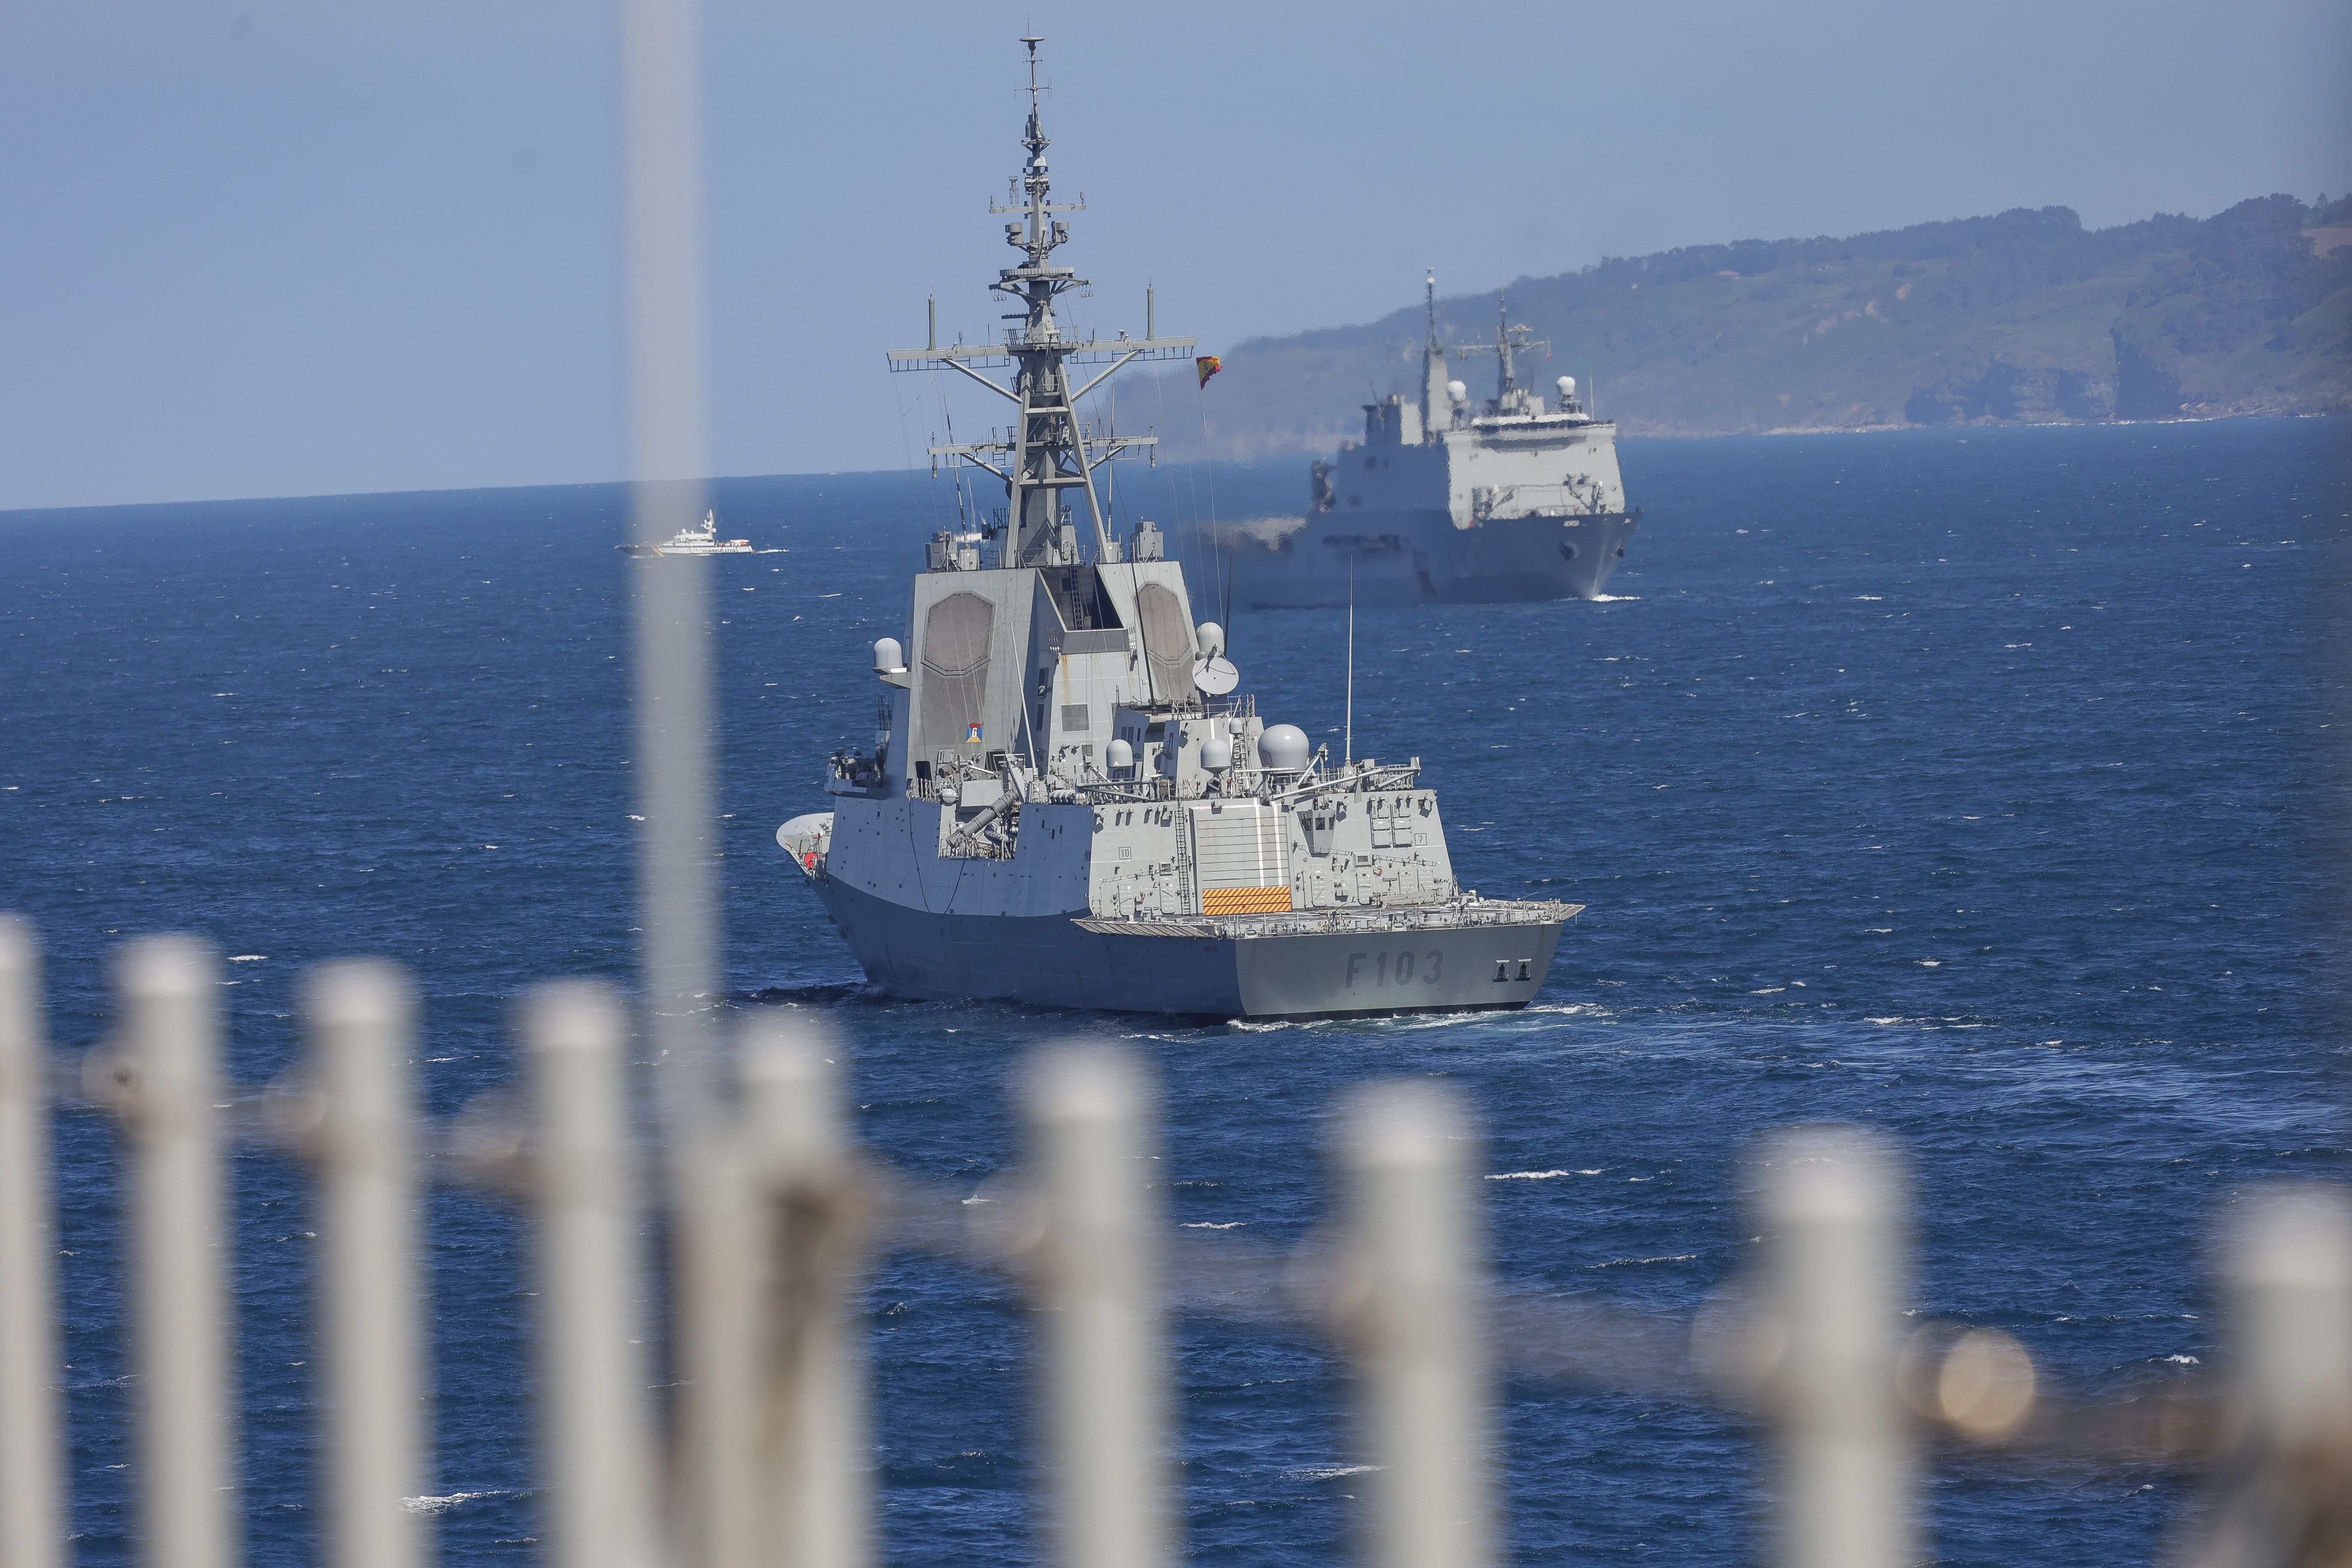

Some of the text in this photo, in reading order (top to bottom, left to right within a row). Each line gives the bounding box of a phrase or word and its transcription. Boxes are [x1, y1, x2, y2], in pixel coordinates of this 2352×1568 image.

[971, 727, 977, 738] 6
[1418, 835, 1423, 843] 7
[1121, 849, 1129, 857] 10
[1345, 949, 1443, 989] F103
